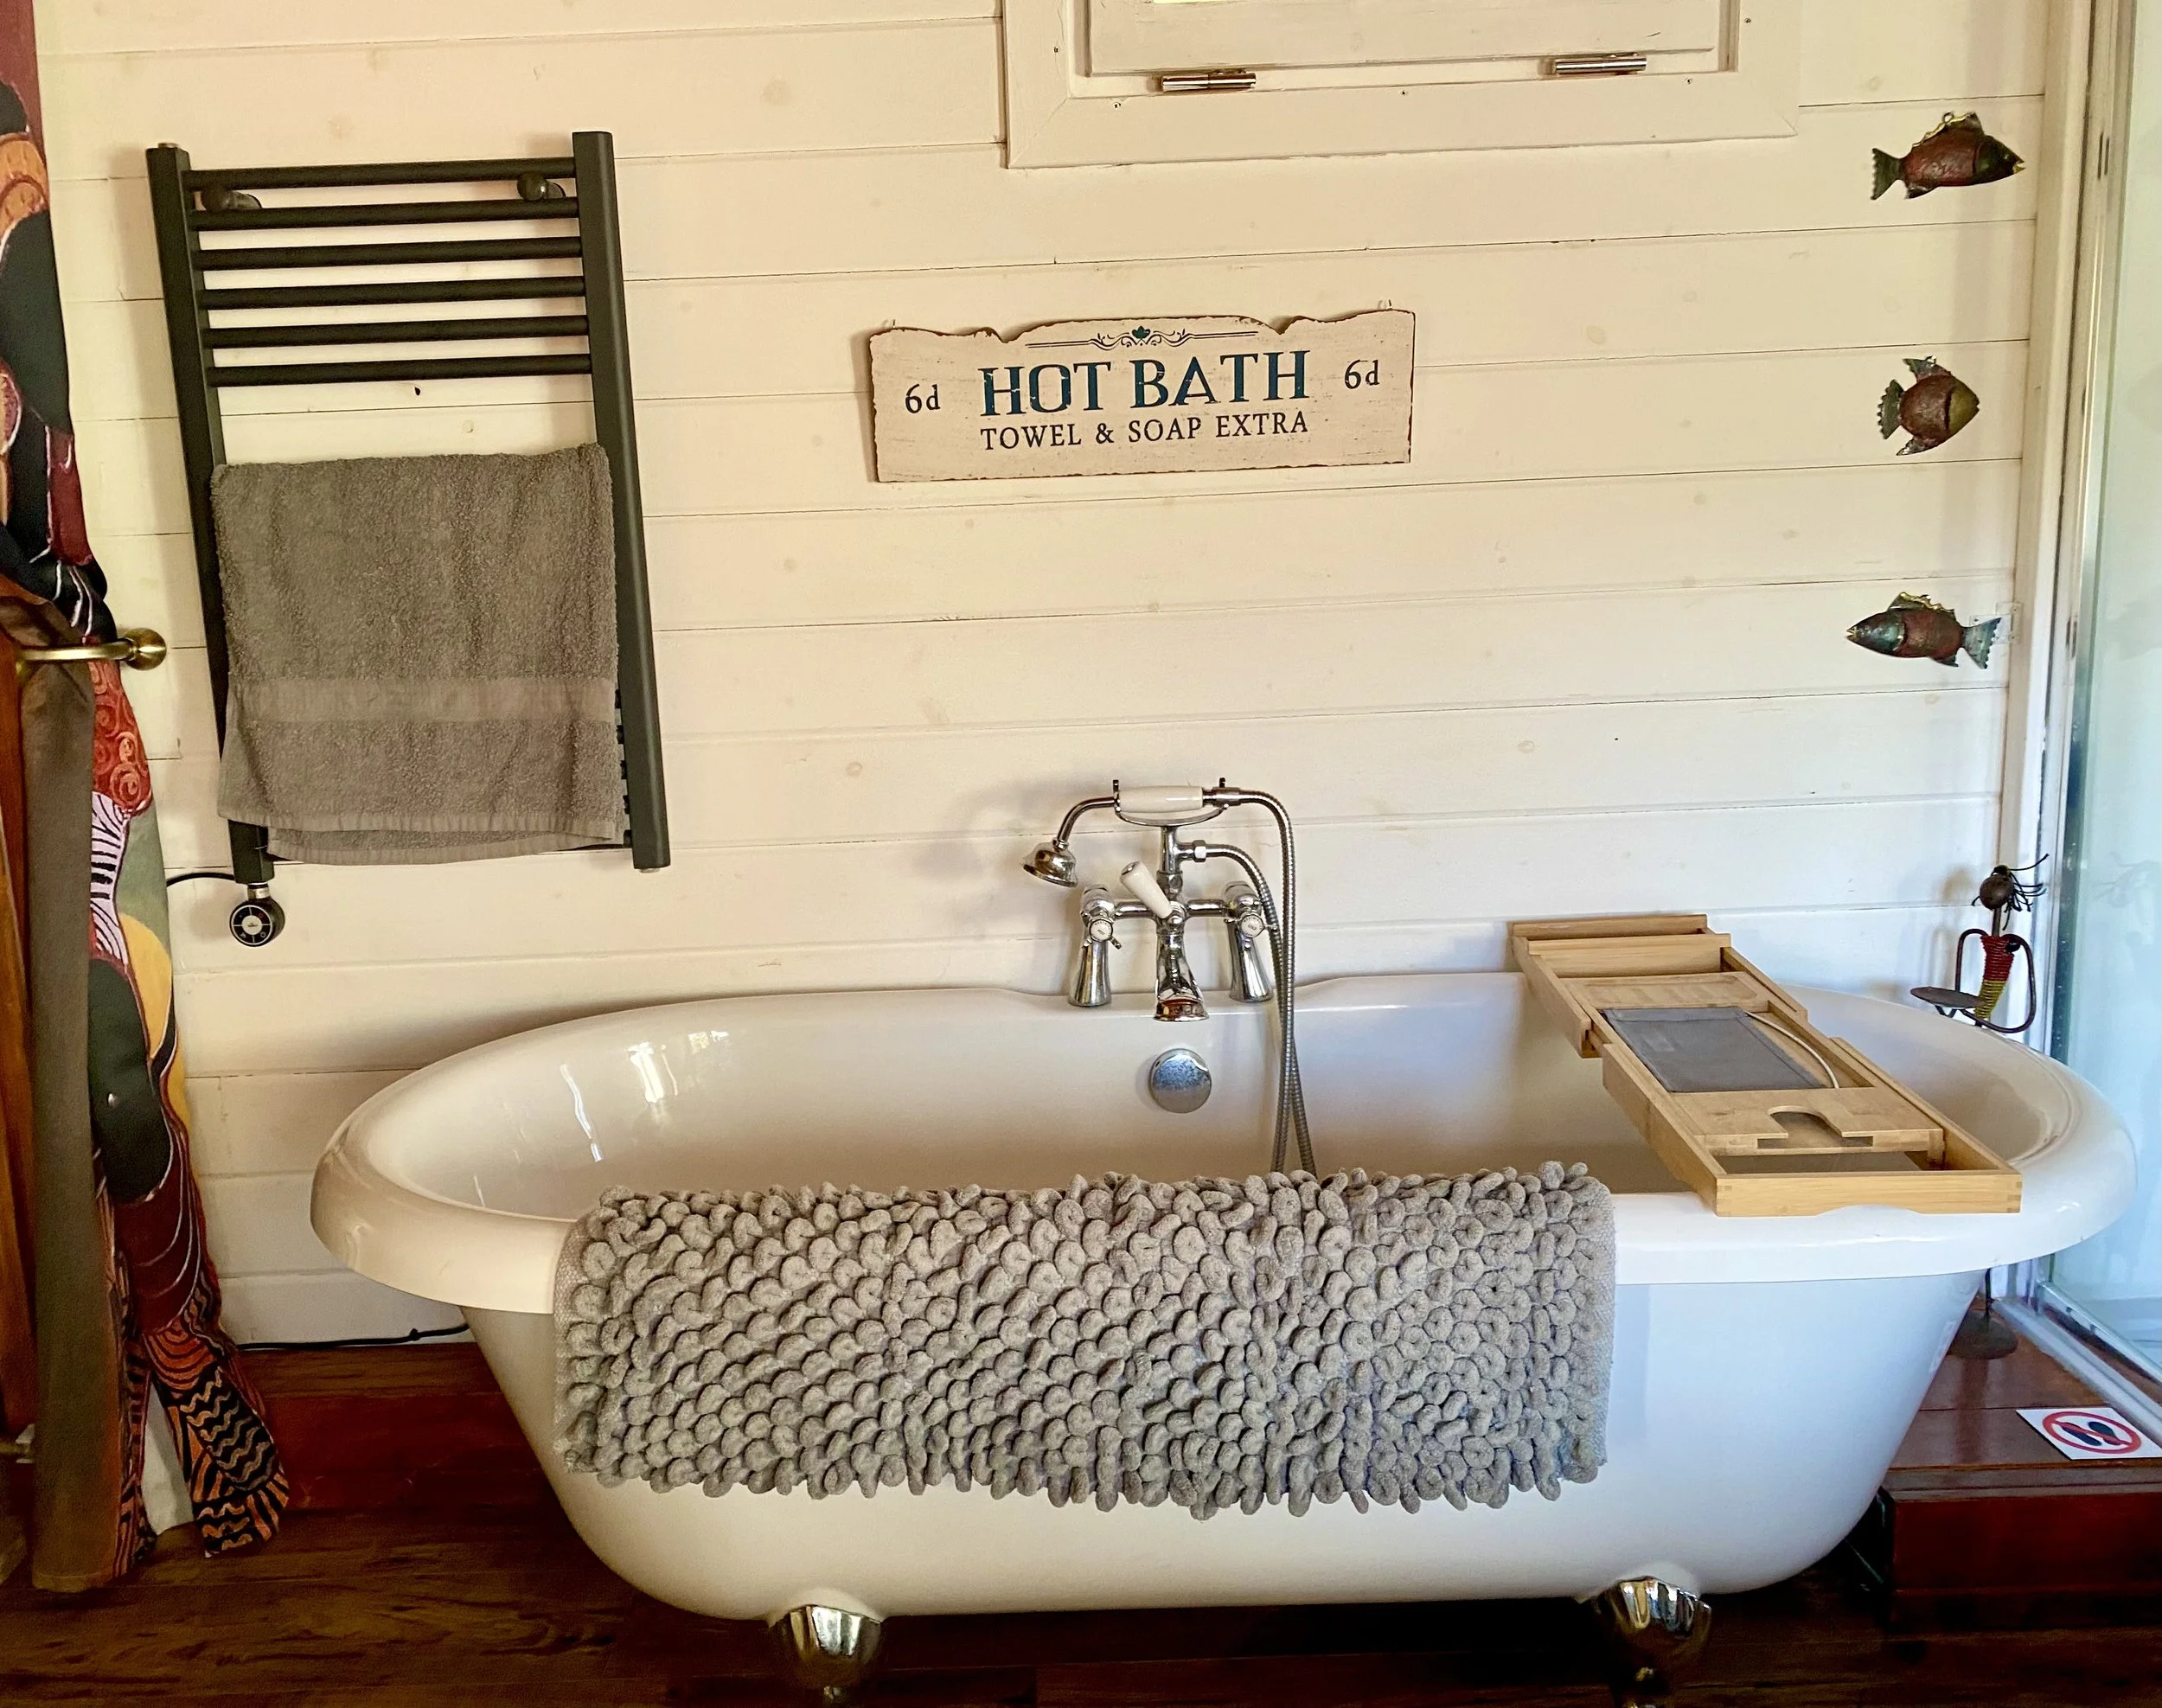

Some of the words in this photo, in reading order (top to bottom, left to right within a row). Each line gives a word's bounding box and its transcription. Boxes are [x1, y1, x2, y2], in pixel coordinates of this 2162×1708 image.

[977, 361, 1111, 417] HOT
[1129, 349, 1311, 409] BATH
[1344, 359, 1380, 390] 6d
[905, 383, 941, 414] 6d
[980, 423, 1082, 451] TOWEL
[1095, 422, 1115, 445] &
[1128, 417, 1201, 443] SOAP
[1215, 410, 1308, 438] EXTRA
